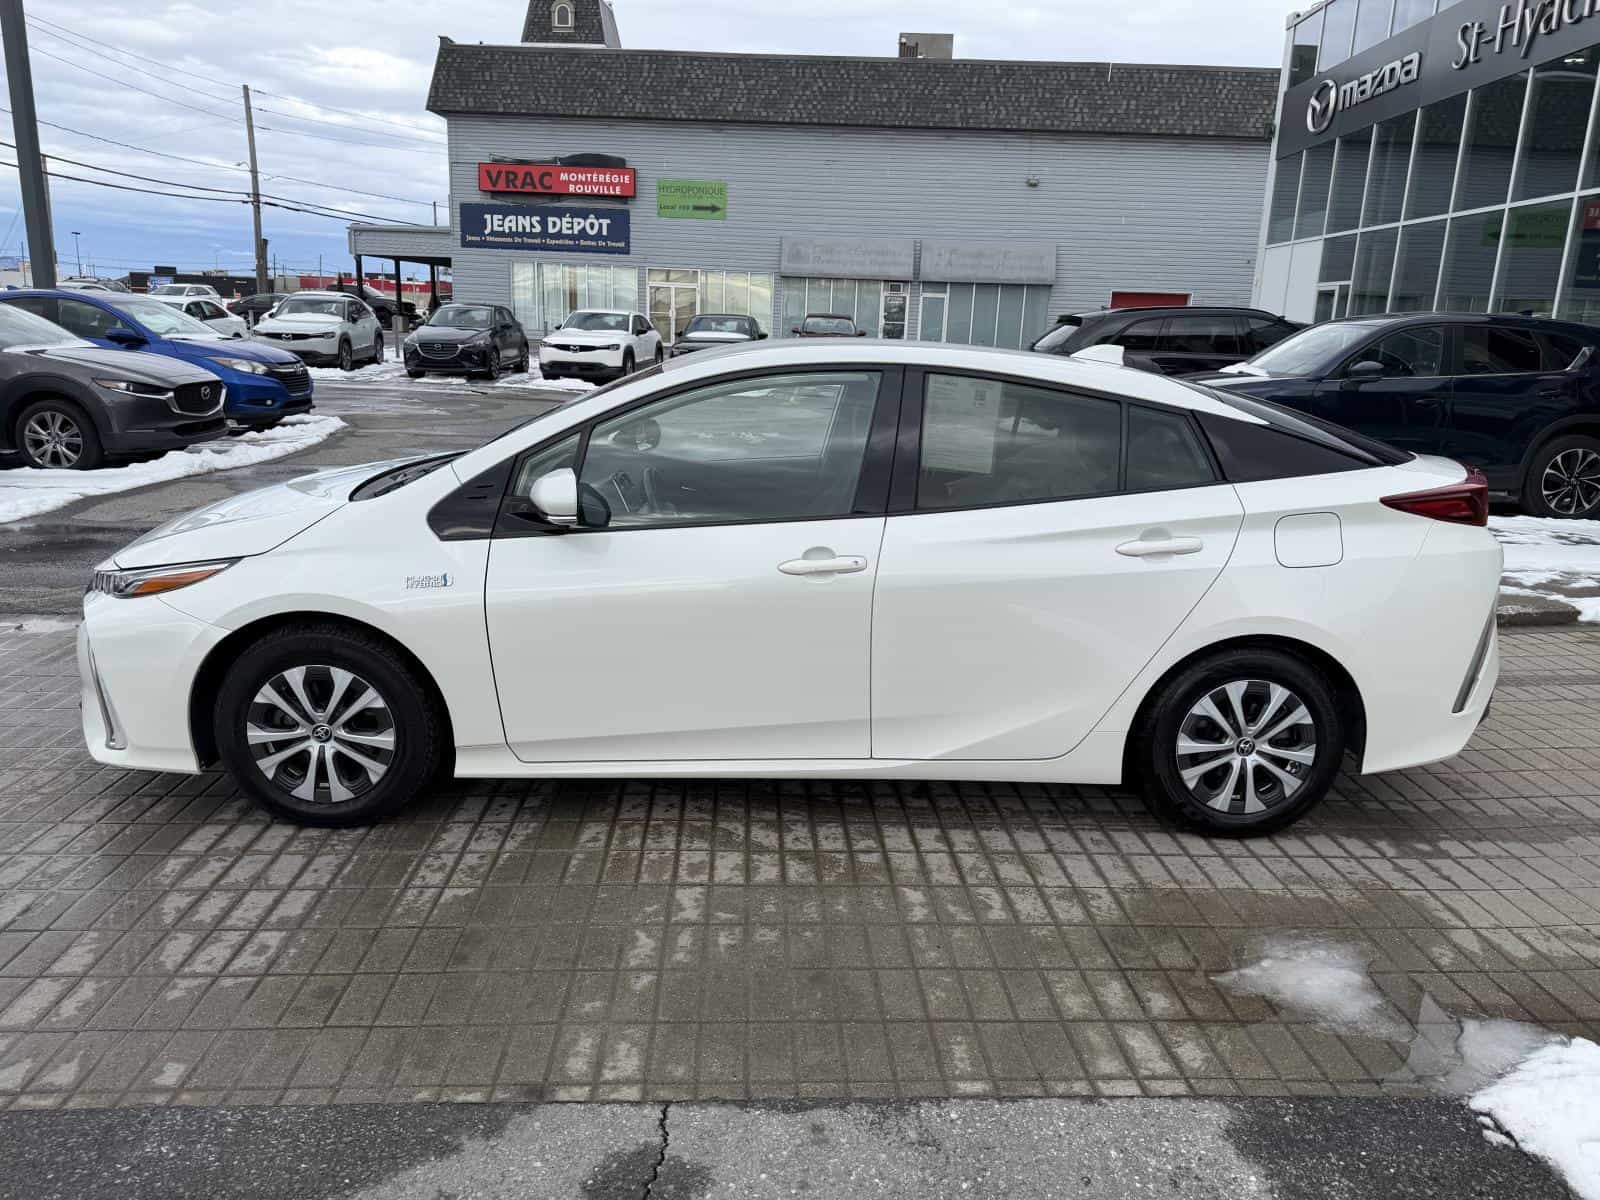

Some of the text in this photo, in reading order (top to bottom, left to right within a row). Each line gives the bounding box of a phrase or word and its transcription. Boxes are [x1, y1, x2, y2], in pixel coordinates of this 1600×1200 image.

[1452, 0, 1600, 70] St-Hyac
[486, 169, 552, 190] VRAC
[559, 171, 630, 184] MONTÉRÉGIE
[568, 184, 622, 195] ROUVILLE
[484, 213, 611, 236] JEANS DÉPÔT
